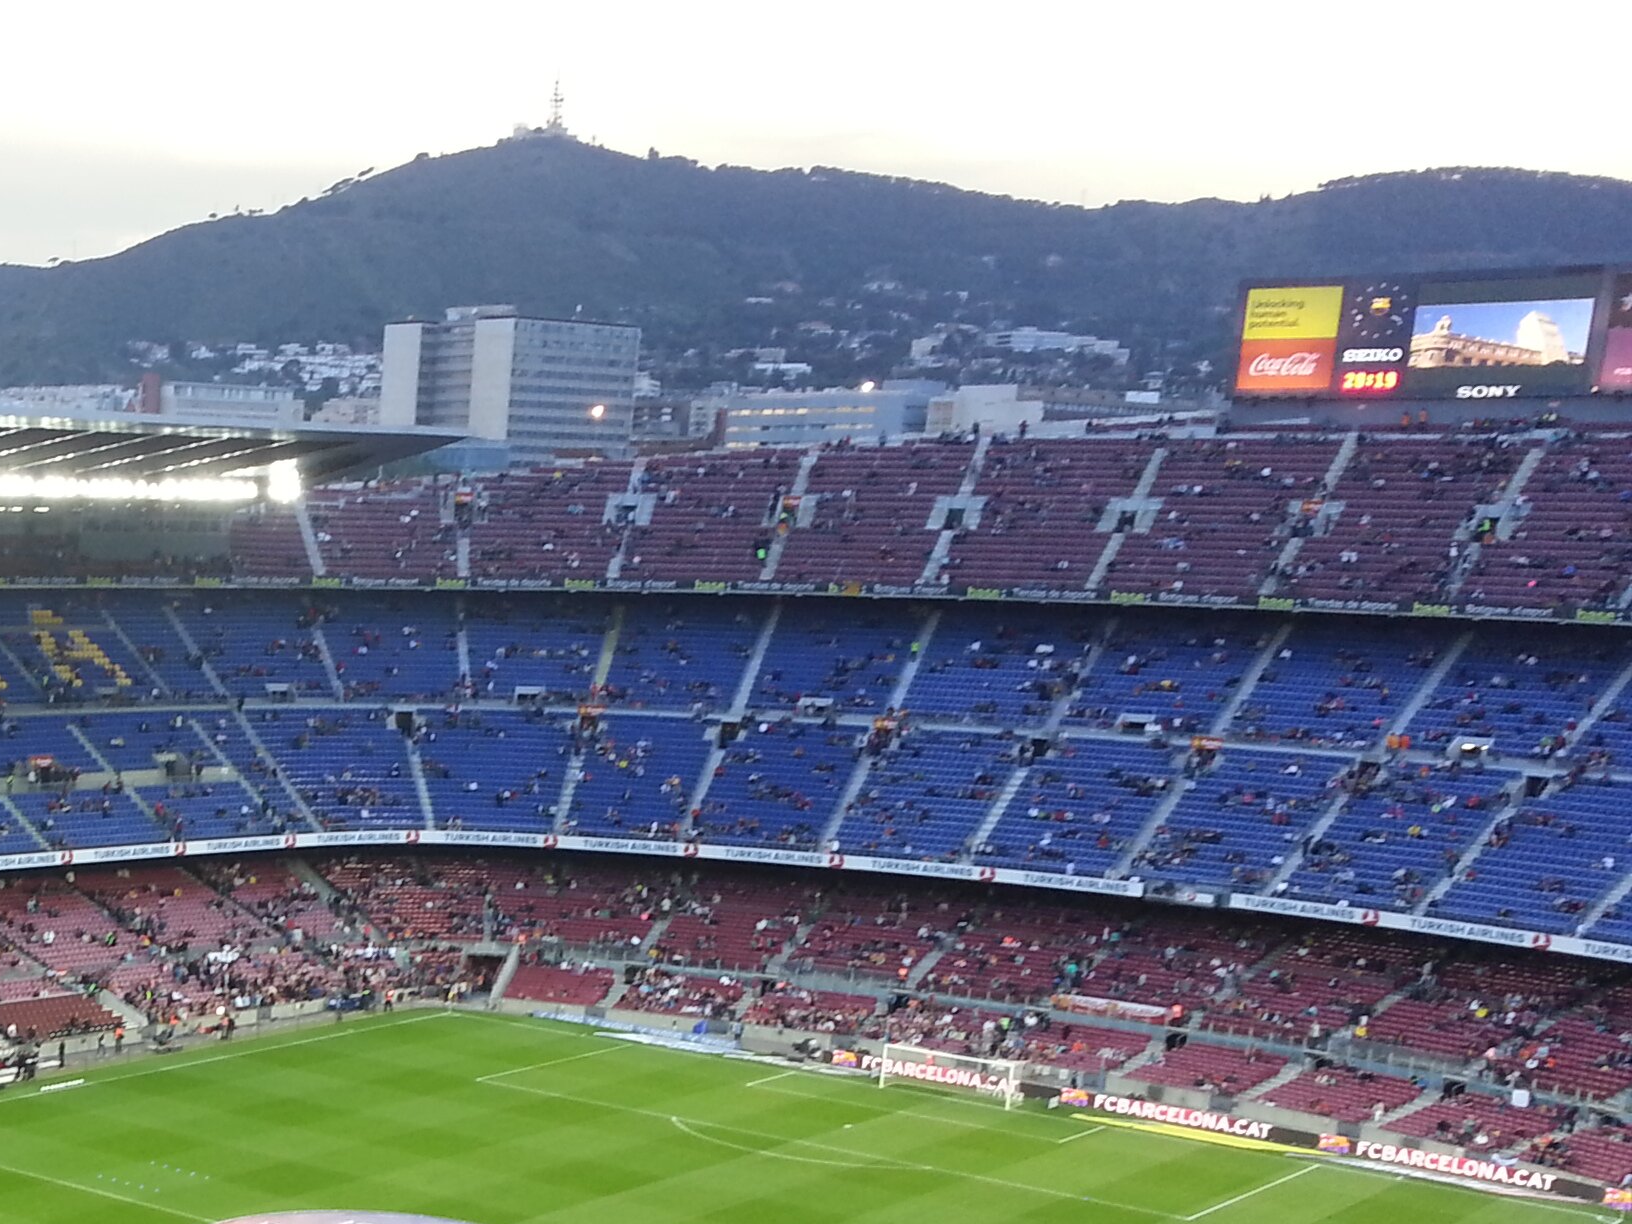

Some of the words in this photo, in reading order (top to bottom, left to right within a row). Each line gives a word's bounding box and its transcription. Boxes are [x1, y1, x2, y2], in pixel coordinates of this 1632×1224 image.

[1342, 347, 1404, 363] SEIKO
[1456, 383, 1522, 399] SONY
[444, 832, 490, 843] TURKISH
[491, 834, 538, 845] AIRLINES
[583, 839, 629, 850] TURKISH
[631, 842, 678, 853] AIRLINES
[18, 854, 56, 866] AIRLINES
[724, 849, 771, 861] TURKISH
[774, 853, 823, 865] AIRLINES
[871, 860, 919, 872] TURKISH
[922, 864, 973, 878] AIRLINES
[1023, 873, 1073, 887] TURKISH
[1073, 878, 1129, 893] AIRLINES
[1244, 898, 1296, 913] TURKISH
[1299, 903, 1355, 920] AIRLINES
[1410, 918, 1465, 934] TURKISH
[1466, 925, 1526, 943] AIRLINES
[1584, 942, 1632, 960] TURKIS
